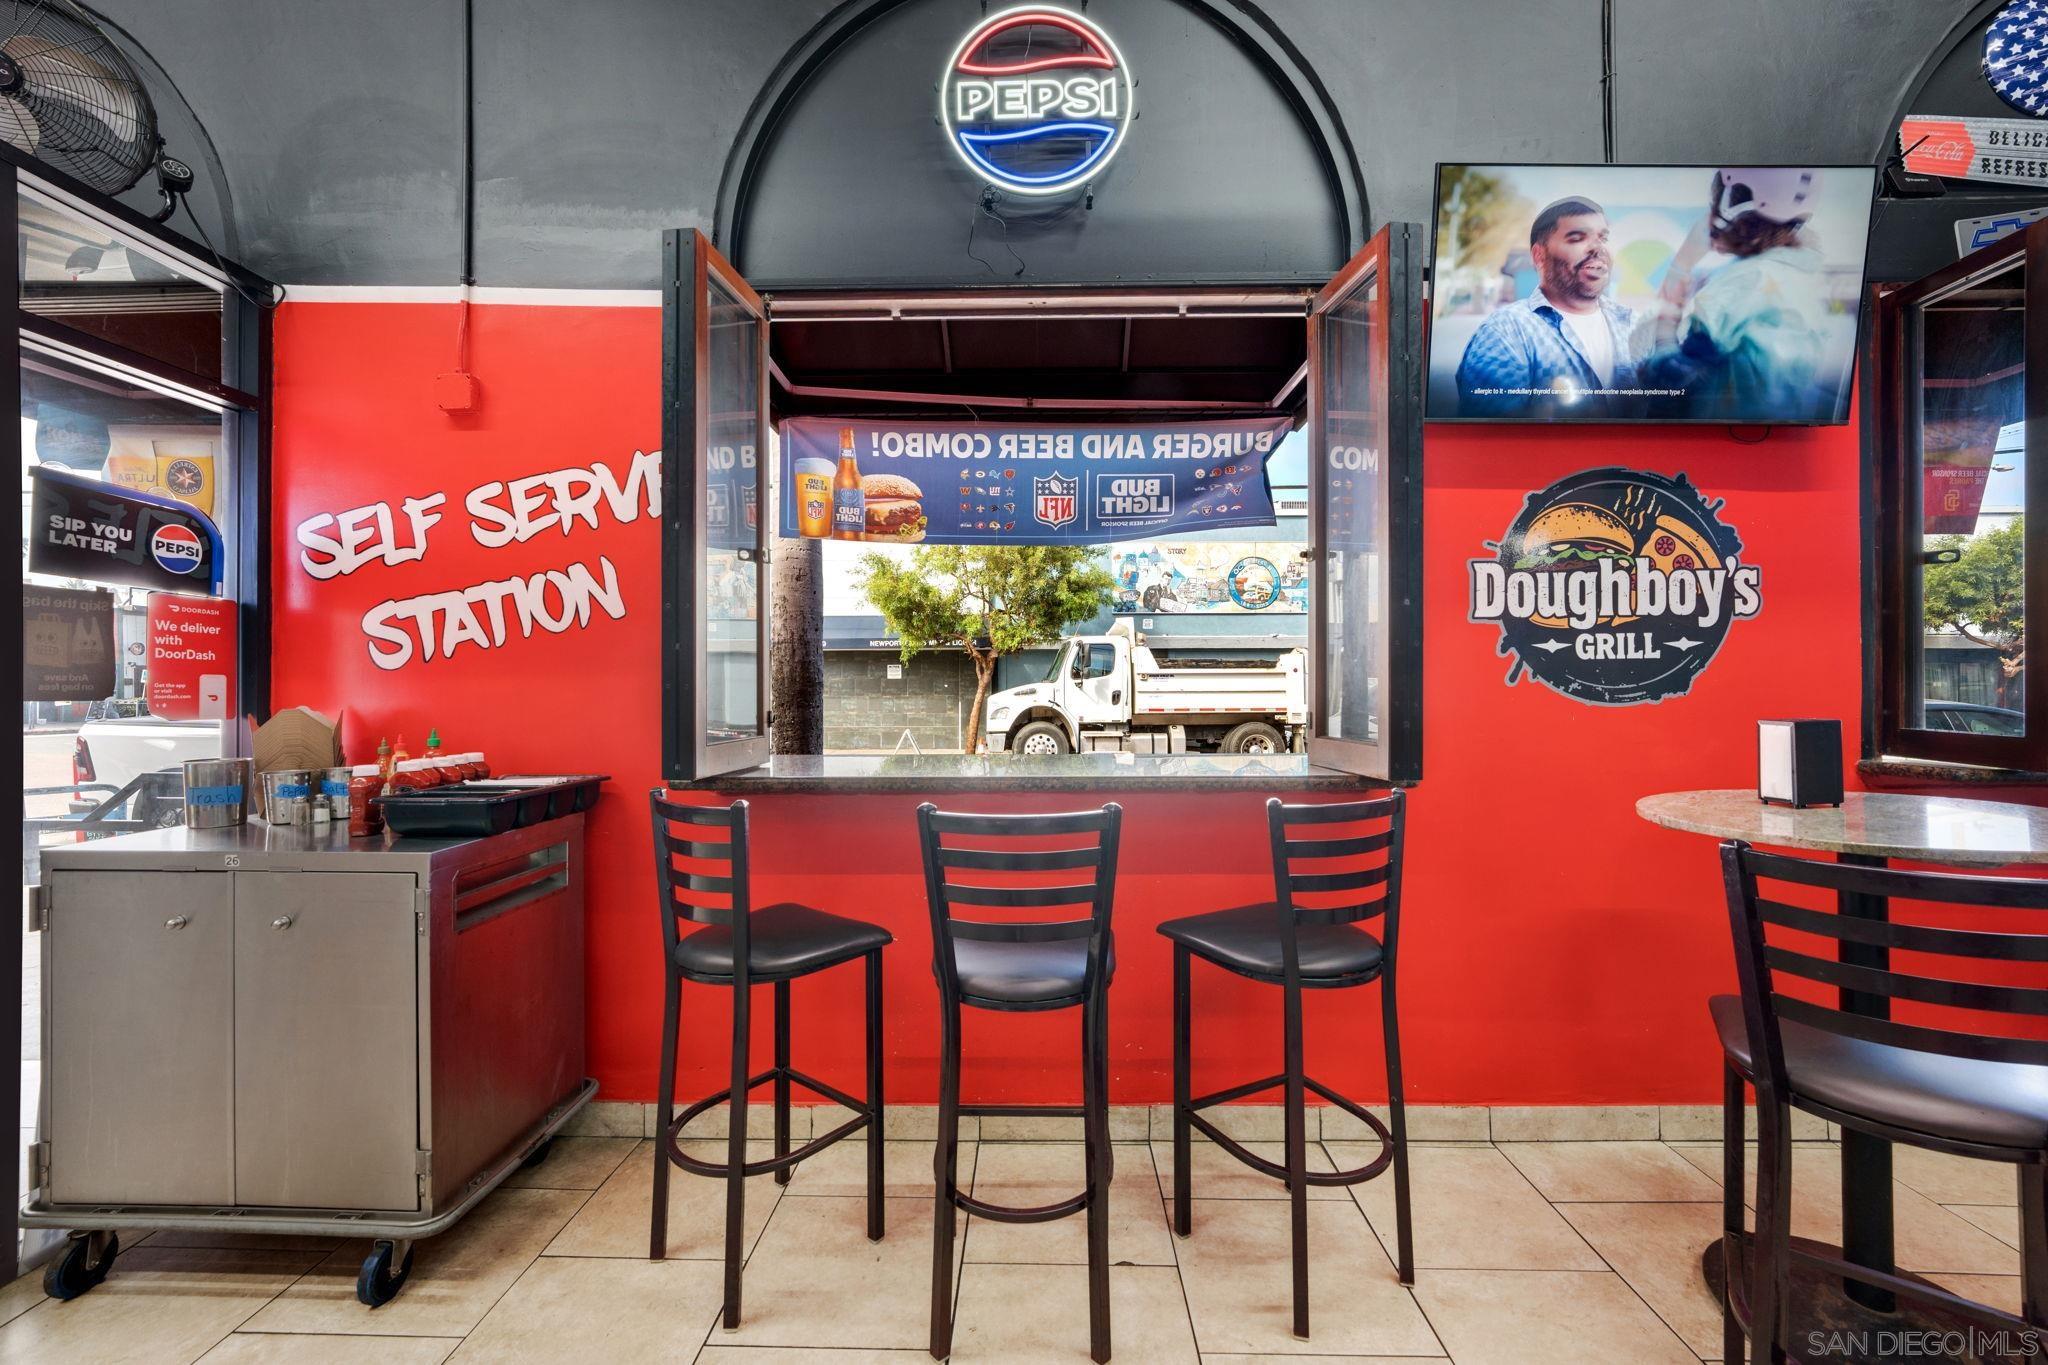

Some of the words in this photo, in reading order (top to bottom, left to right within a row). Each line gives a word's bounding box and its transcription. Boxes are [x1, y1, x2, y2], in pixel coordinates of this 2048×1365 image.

[957, 77, 1117, 121] PEPSI
[1981, 157, 2048, 178] REFRES
[1507, 387, 1532, 396] medullary
[1533, 387, 1551, 396] thyroid
[1594, 387, 1619, 395] endocrine
[1620, 387, 1644, 396] neoplasia
[1644, 388, 1669, 396] syndrome
[1669, 388, 1681, 397] type
[1329, 445, 1379, 472] COM
[49, 514, 87, 532] SIP
[91, 521, 133, 542] YOU
[297, 492, 446, 581] SELF
[49, 529, 118, 554] LATER
[154, 540, 200, 558] PEPSI
[1472, 555, 1760, 630] Doughboy's
[181, 606, 220, 616] DOORDASH
[361, 555, 627, 671] STATION
[155, 619, 178, 631] We
[180, 622, 221, 634] deliver
[154, 635, 183, 646] with
[1575, 632, 1661, 660] GRILL
[154, 648, 216, 660] DoorDash
[190, 784, 237, 804] Trash
[226, 856, 239, 866] 26
